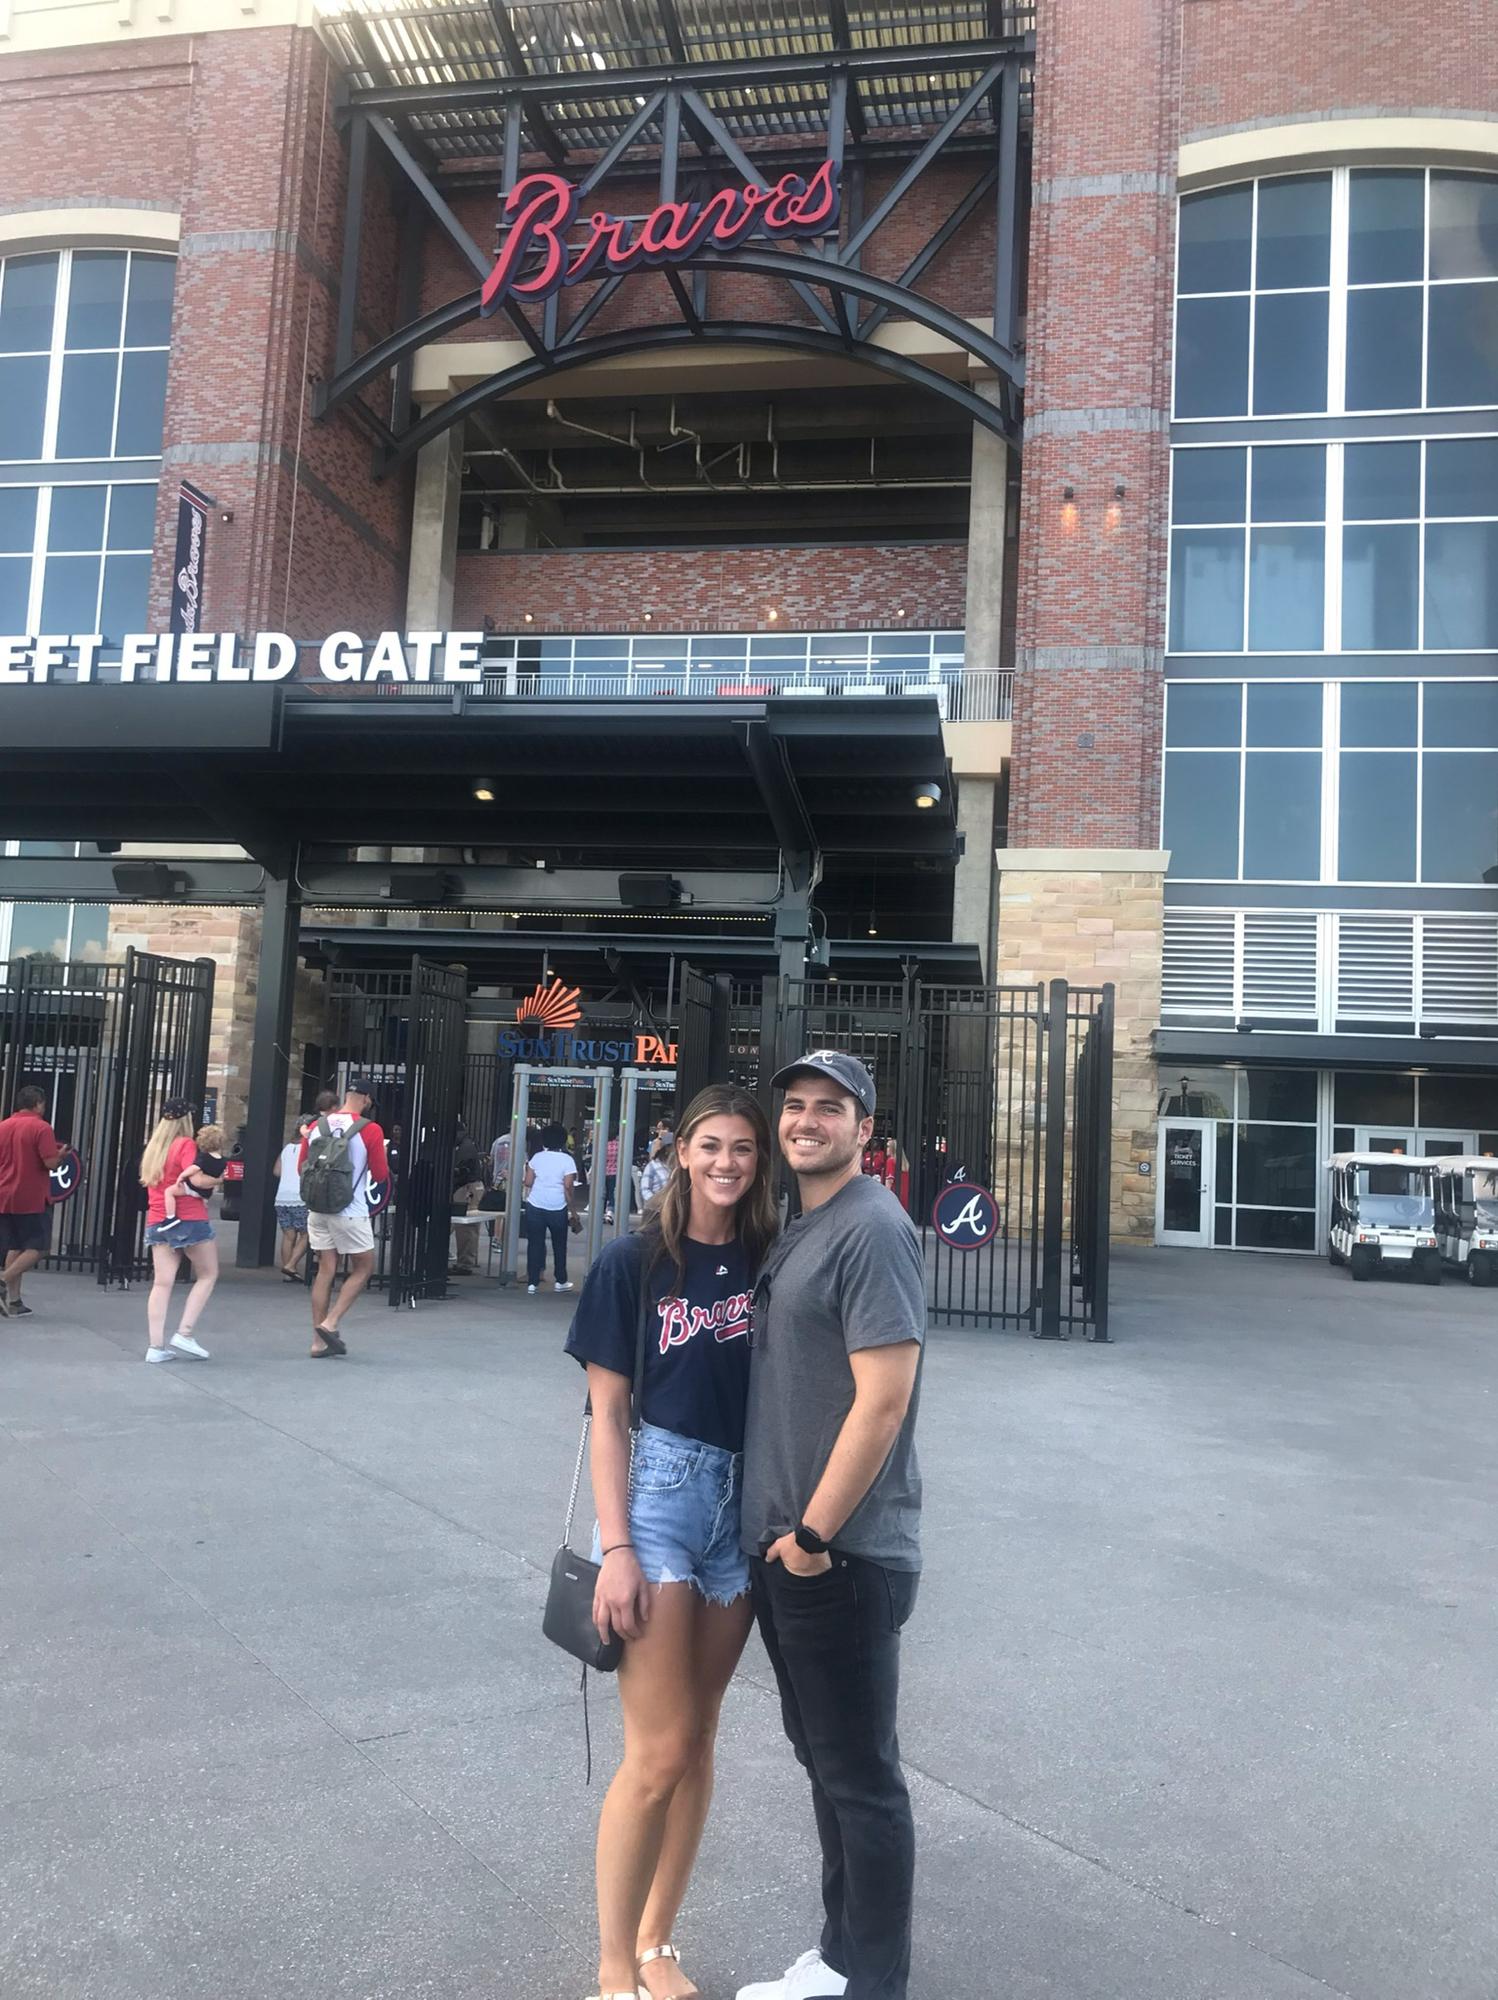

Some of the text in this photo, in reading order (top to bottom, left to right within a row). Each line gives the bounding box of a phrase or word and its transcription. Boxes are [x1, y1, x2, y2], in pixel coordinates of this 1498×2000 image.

[481, 159, 836, 310] Braves
[120, 632, 297, 682] FIELD
[319, 631, 484, 682] GATE
[941, 1193, 987, 1236] A
